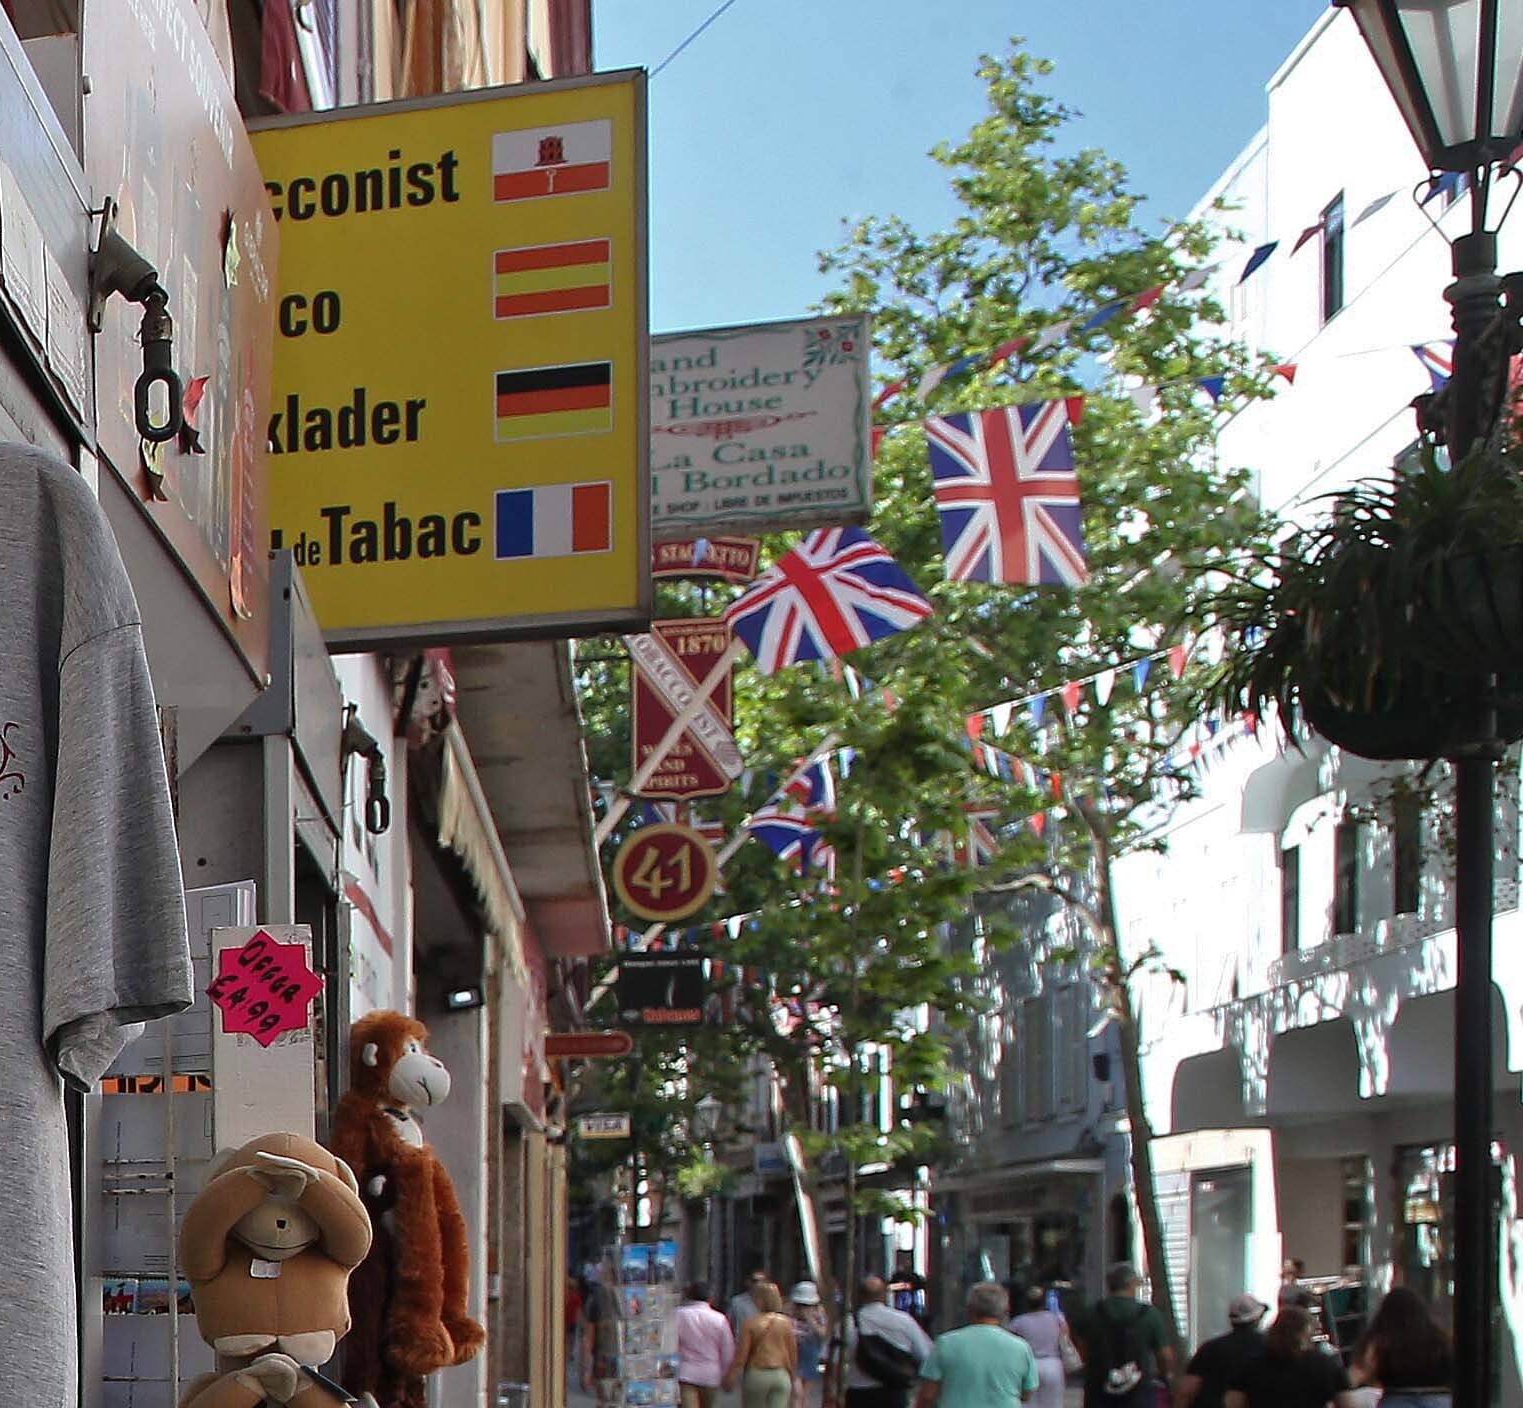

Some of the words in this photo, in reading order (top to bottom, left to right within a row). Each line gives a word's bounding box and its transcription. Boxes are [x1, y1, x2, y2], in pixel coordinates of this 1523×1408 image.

[668, 395, 783, 420] House
[713, 440, 811, 465] Casa
[683, 464, 851, 494] Bordado
[293, 535, 320, 567] de
[320, 502, 483, 566] Tabac
[678, 635, 726, 655] 1870
[632, 845, 692, 899] 41
